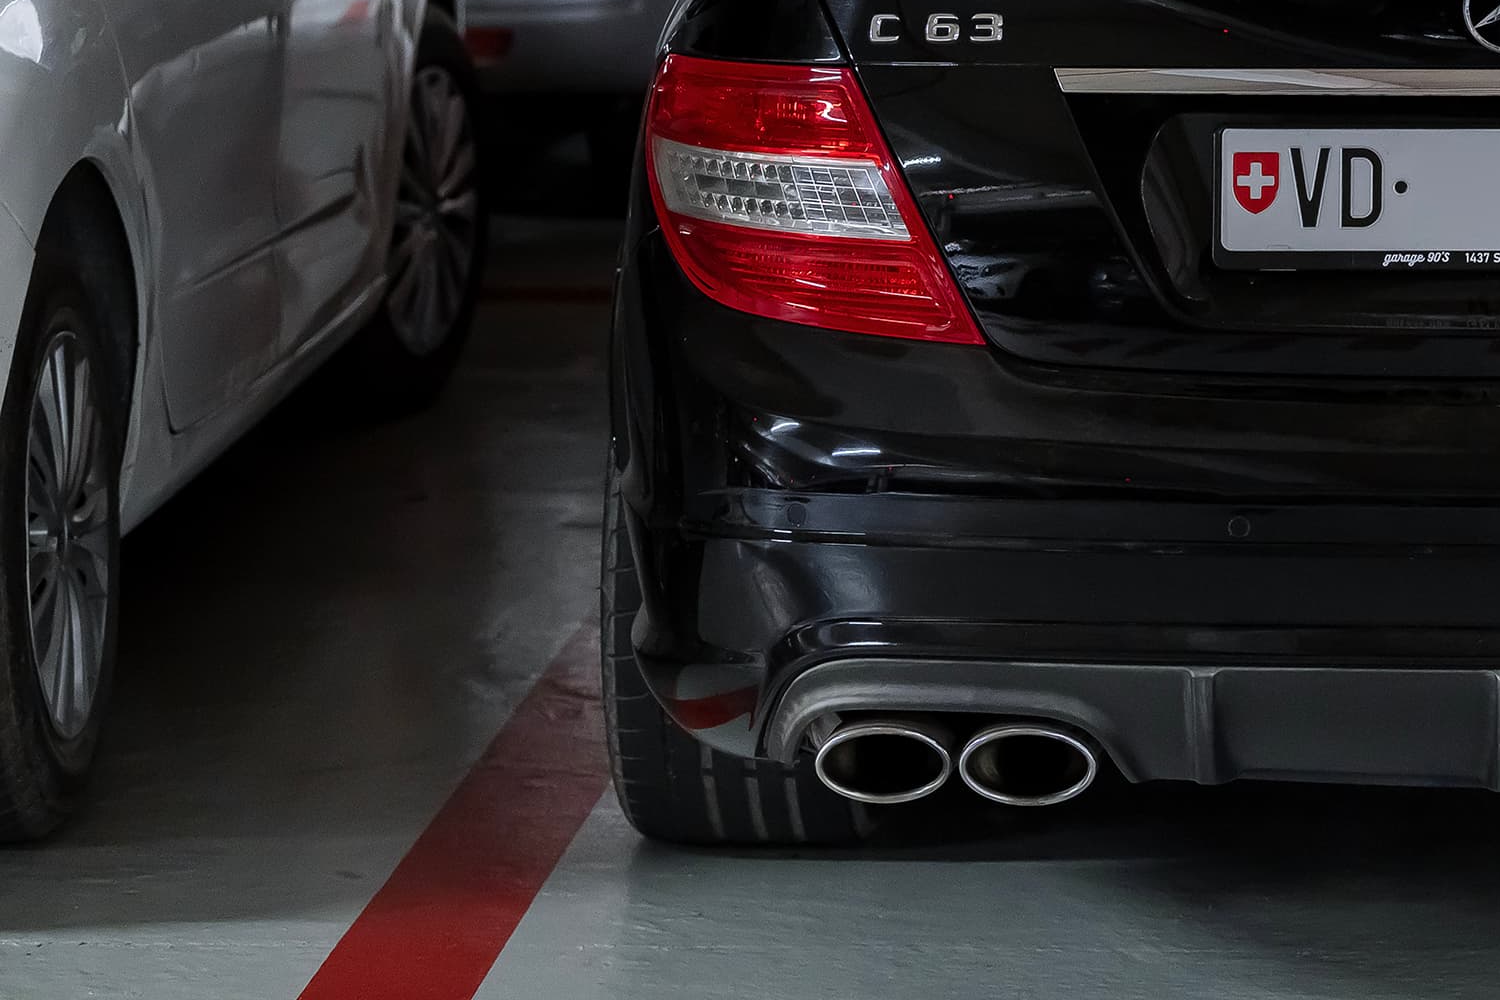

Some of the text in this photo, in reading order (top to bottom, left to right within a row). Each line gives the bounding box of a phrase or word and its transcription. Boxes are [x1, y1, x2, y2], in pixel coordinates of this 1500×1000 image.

[869, 12, 1004, 42] C 63
[1382, 253, 1426, 267] garage
[1465, 252, 1490, 263] 1437
